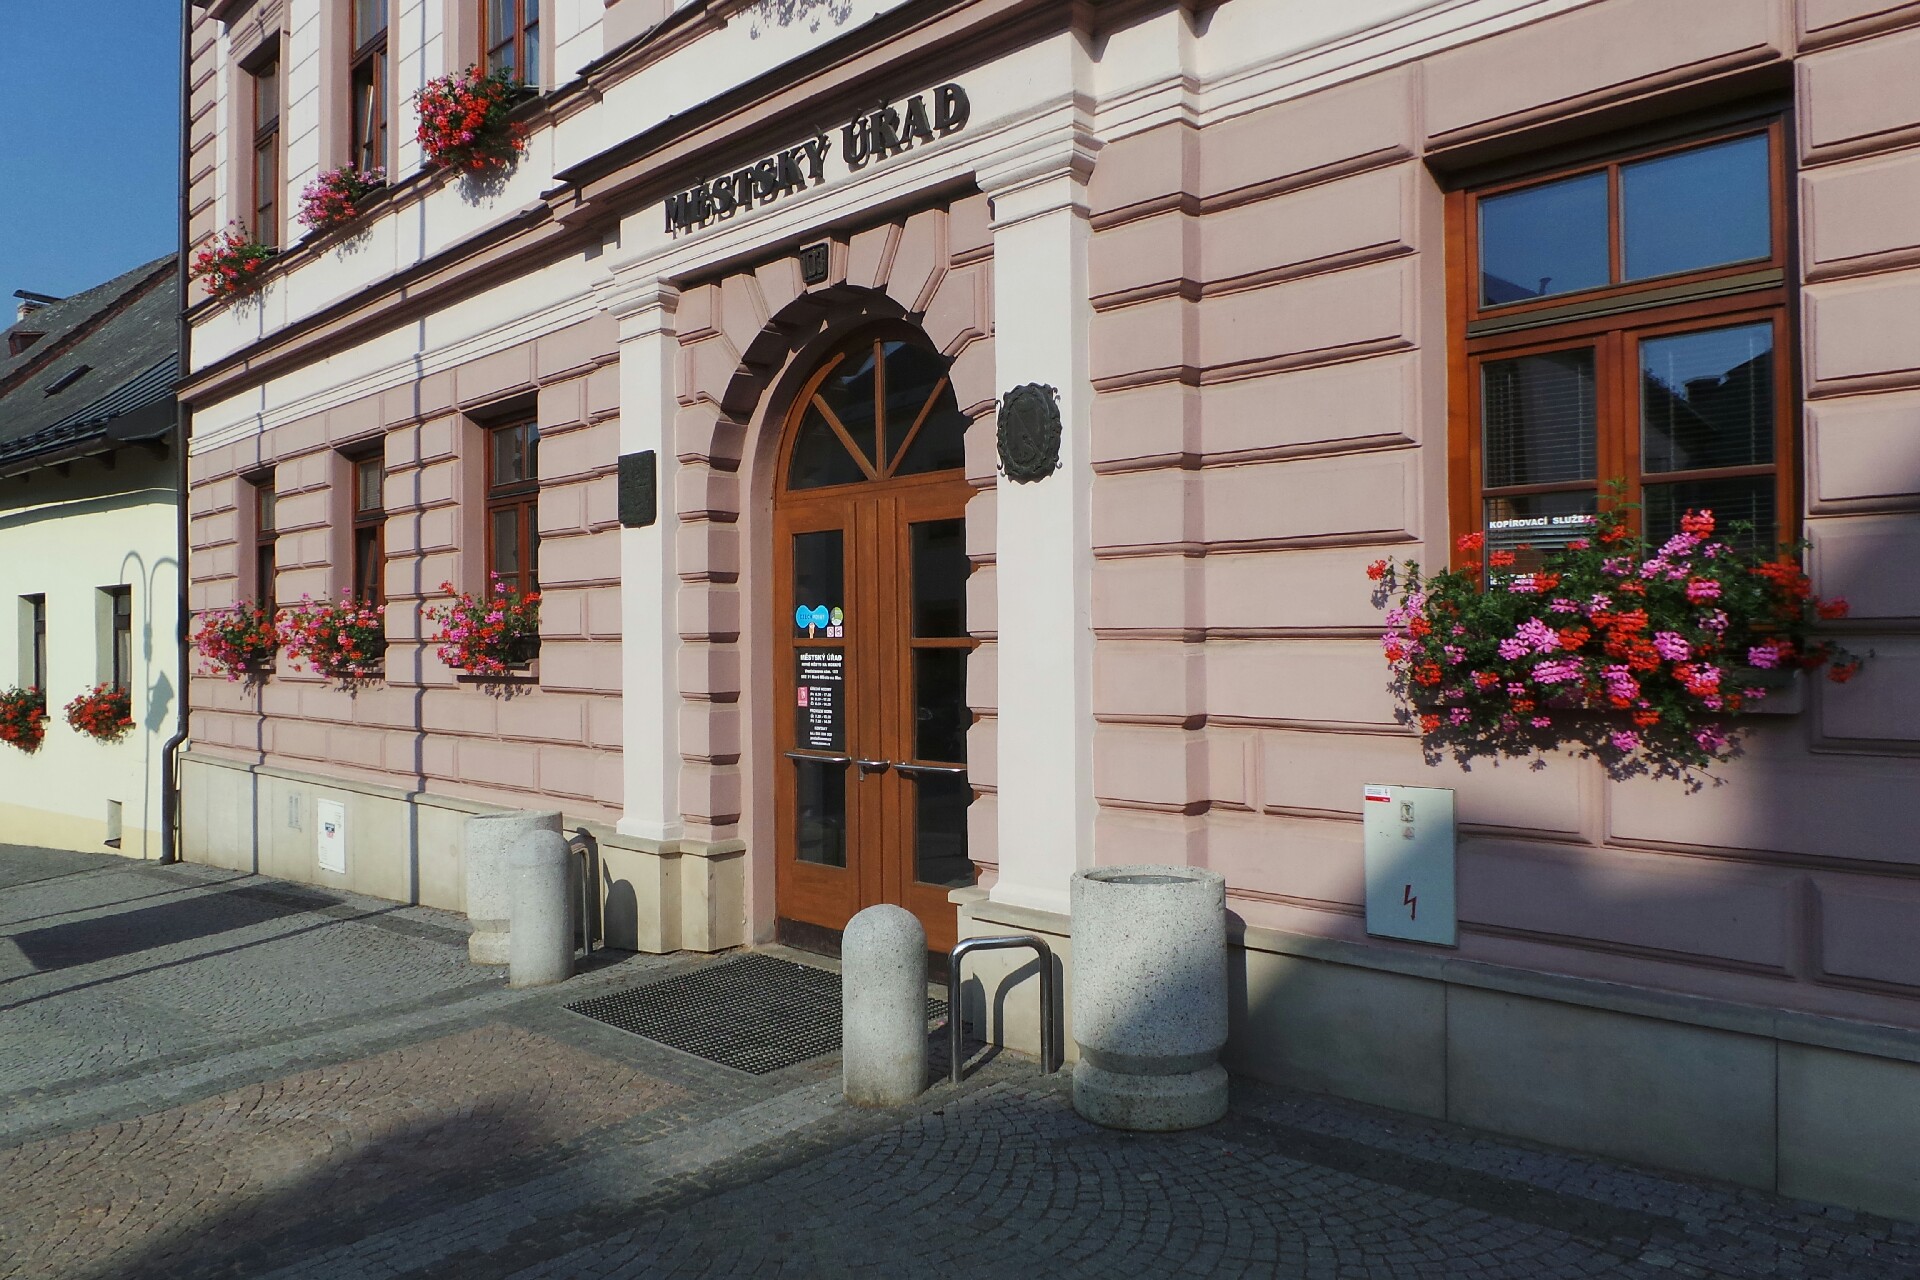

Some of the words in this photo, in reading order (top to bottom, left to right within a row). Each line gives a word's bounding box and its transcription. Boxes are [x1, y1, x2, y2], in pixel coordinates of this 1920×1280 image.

[663, 125, 829, 234] MĚSTSKÝ
[840, 83, 970, 165] ÚŘAD
[1489, 516, 1548, 529] KOPÍROVACÍ
[800, 652, 826, 661] MĚSTSKÝ
[826, 652, 843, 661] ÚŘAD
